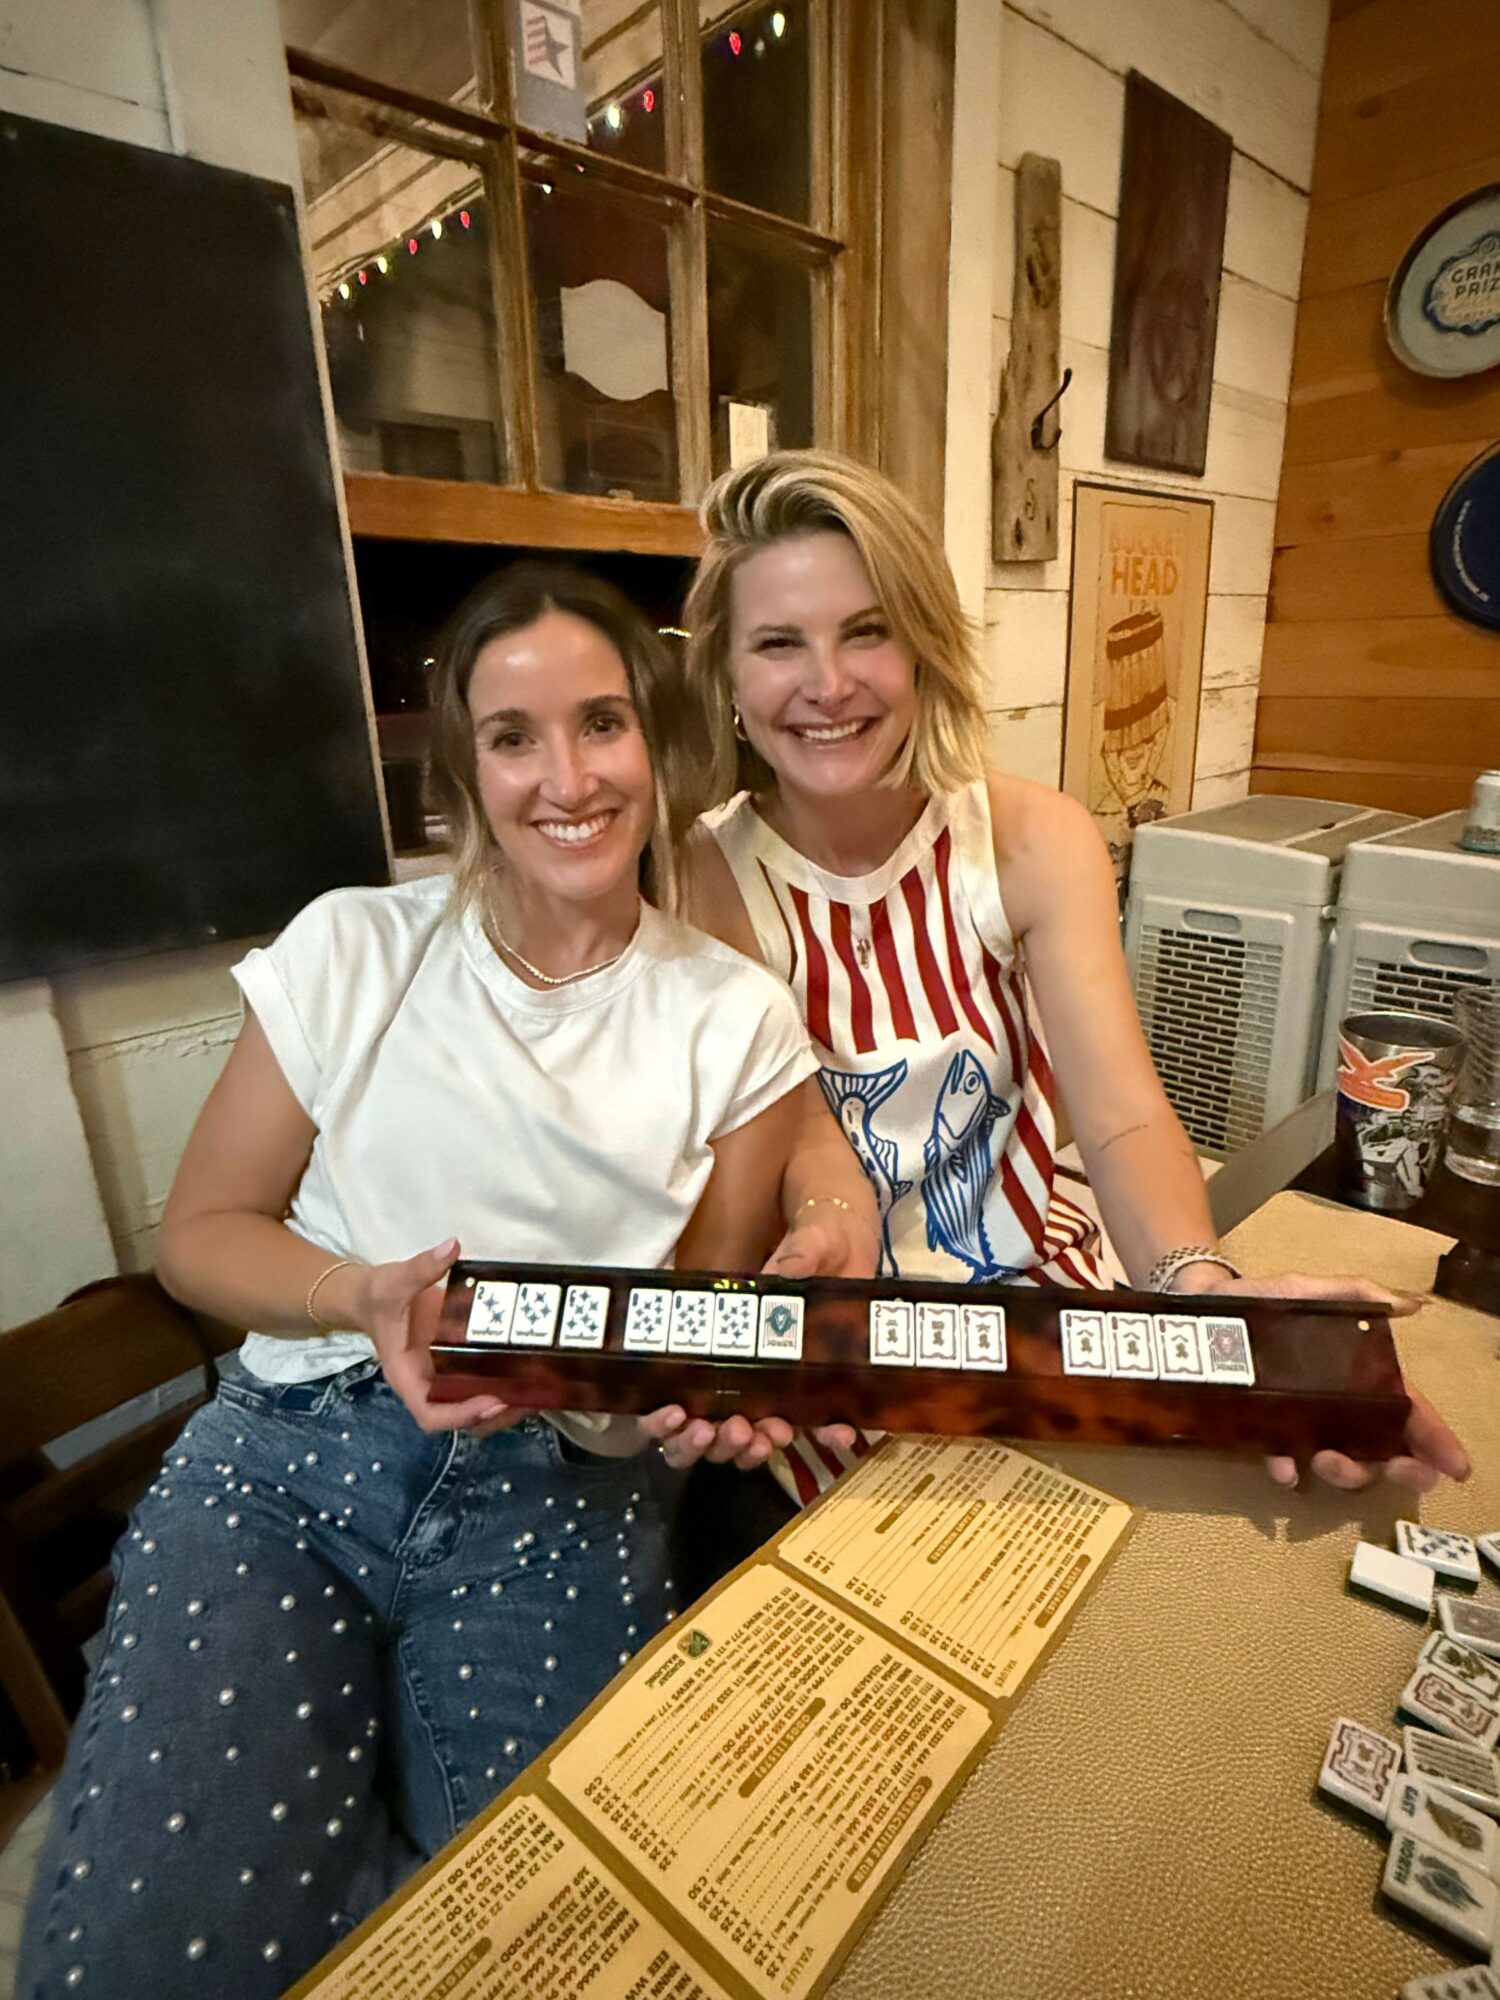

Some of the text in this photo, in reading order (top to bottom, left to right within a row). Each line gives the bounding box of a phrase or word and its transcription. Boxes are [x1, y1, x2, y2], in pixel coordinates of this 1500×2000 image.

[1110, 555, 1179, 597] HEAD
[477, 1286, 485, 1300] 2
[869, 1782, 927, 1858] CONSECUTIVE
[1402, 1785, 1419, 1817] EAST
[851, 1855, 875, 1884] RUN
[1394, 1837, 1416, 1886] NORTH
[544, 1922, 577, 1958] NEWS
[777, 1944, 816, 1994] VALUES
